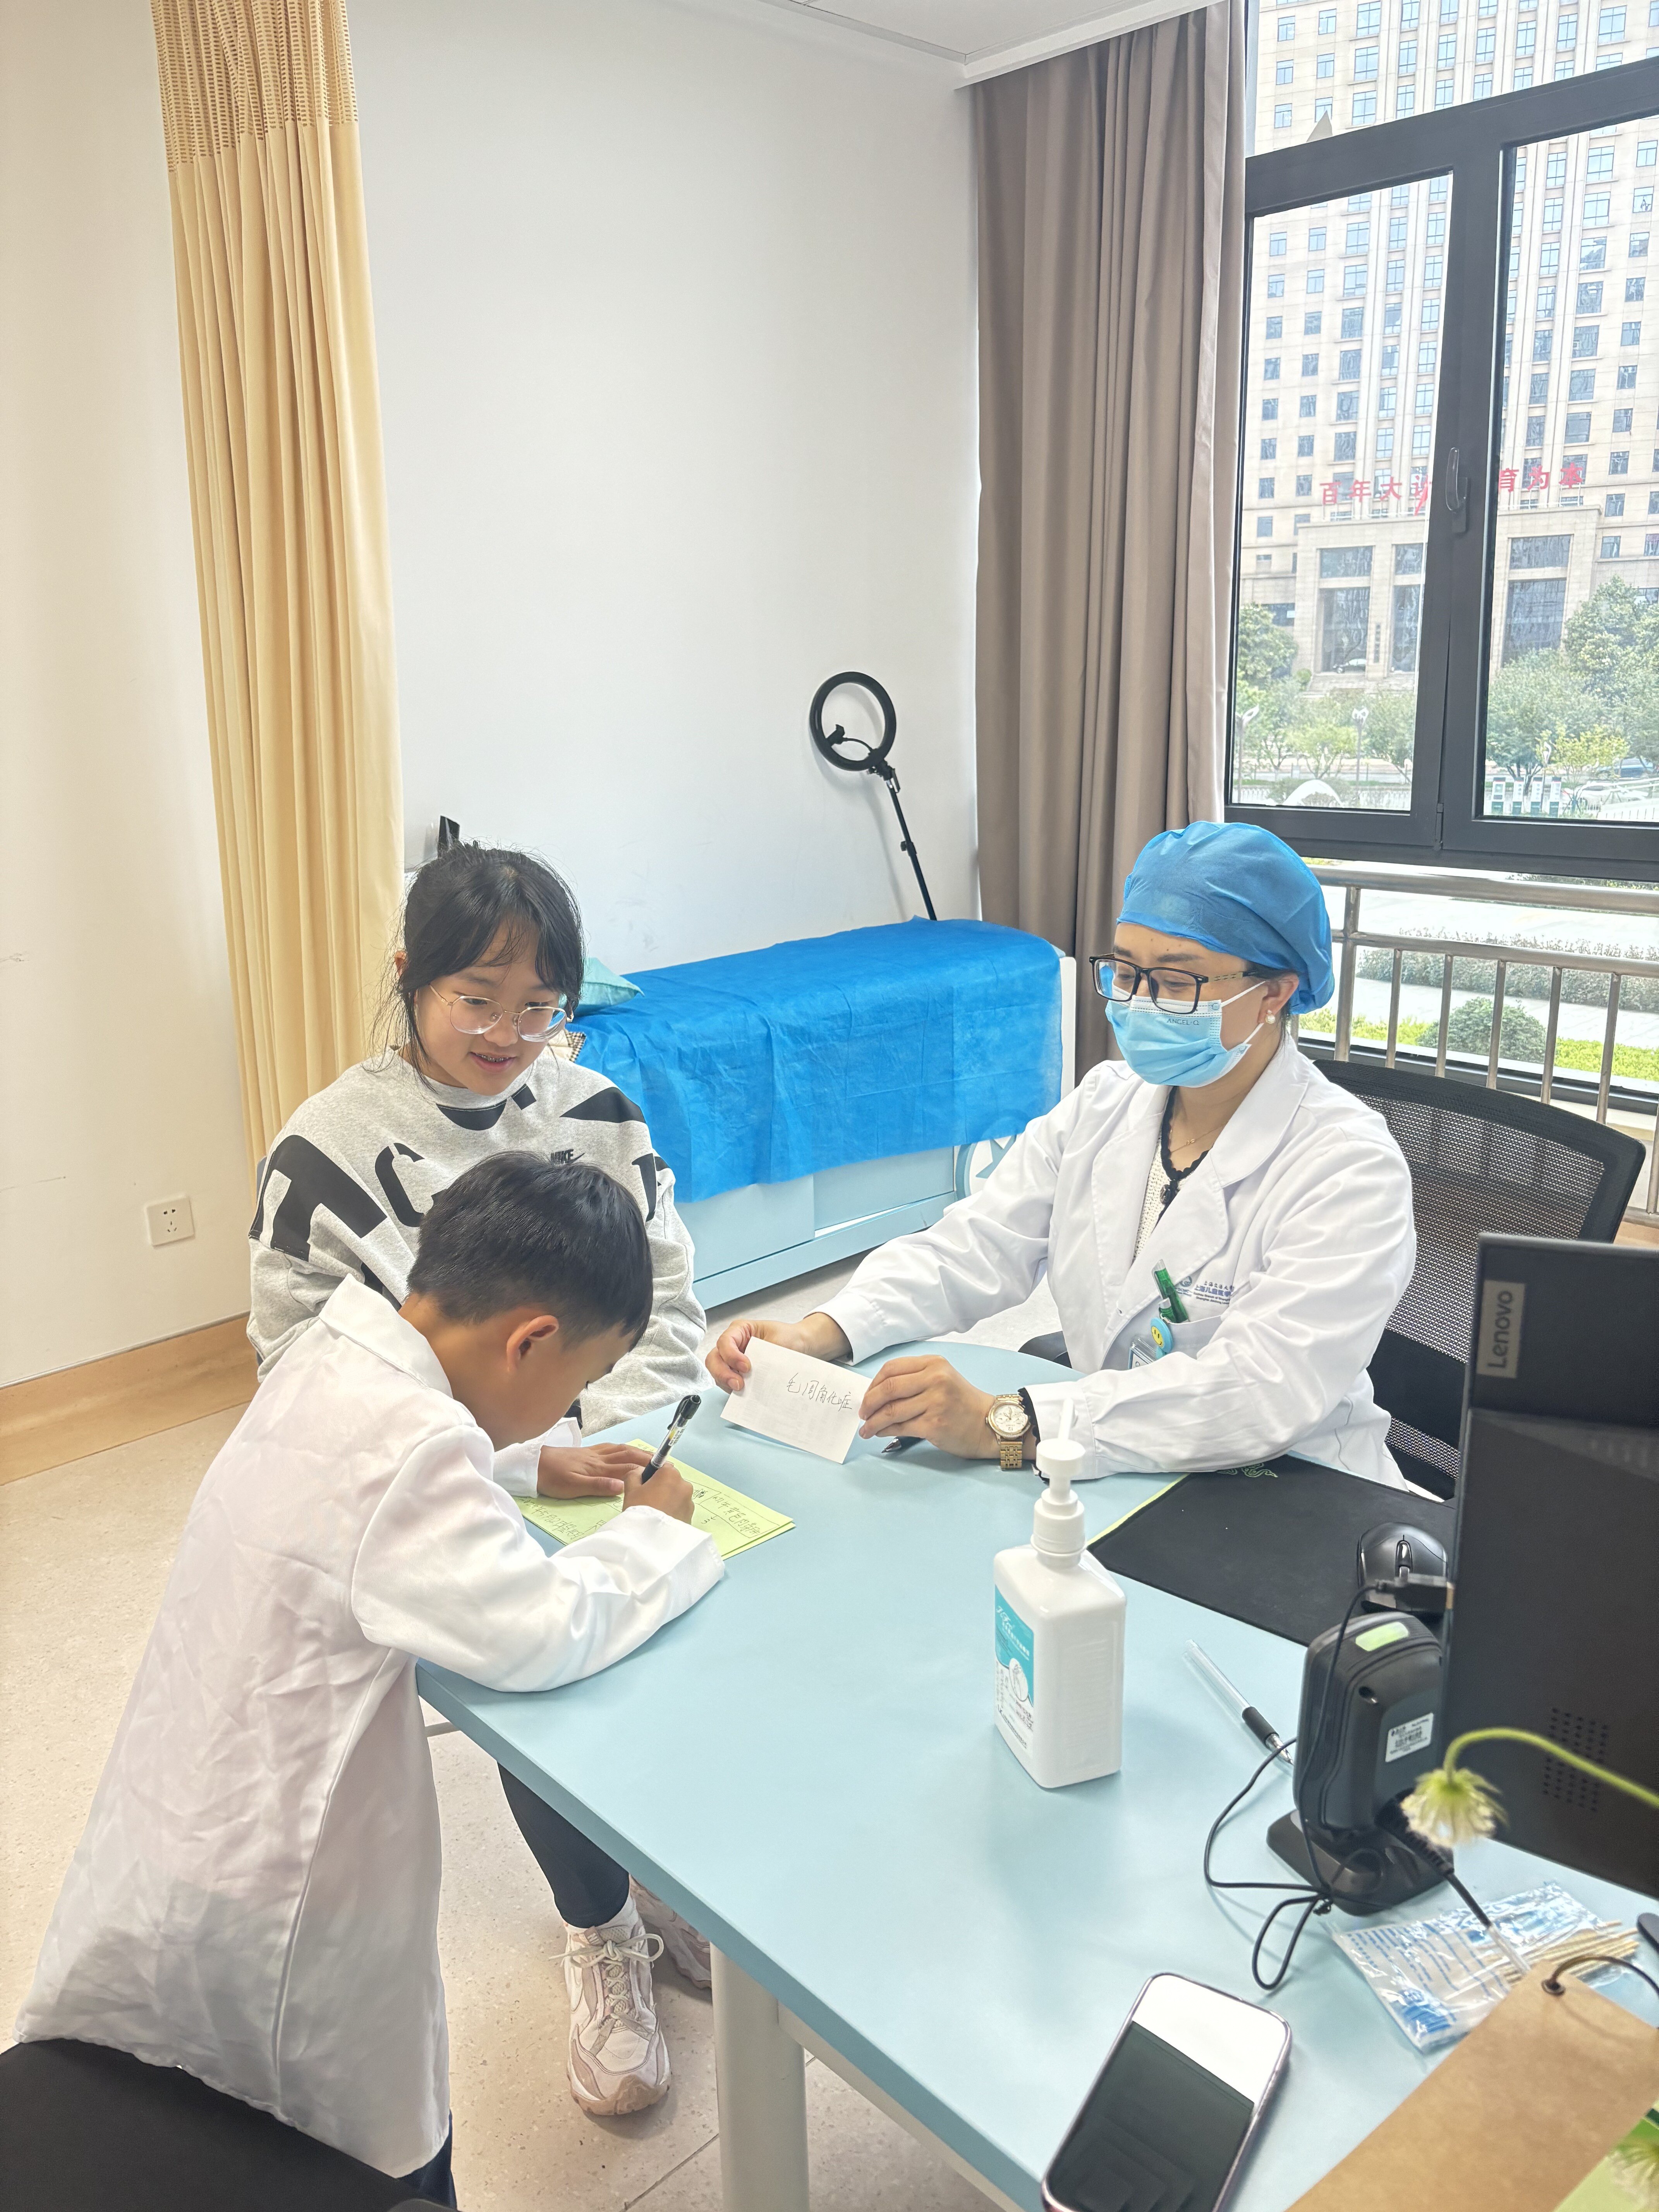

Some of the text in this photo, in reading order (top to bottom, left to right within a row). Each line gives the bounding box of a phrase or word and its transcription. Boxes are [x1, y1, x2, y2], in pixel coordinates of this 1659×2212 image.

[551, 1149, 574, 1165] NIKE
[1487, 1291, 1513, 1368] Lenovo
[787, 1372, 852, 1412] 毛周角化症
